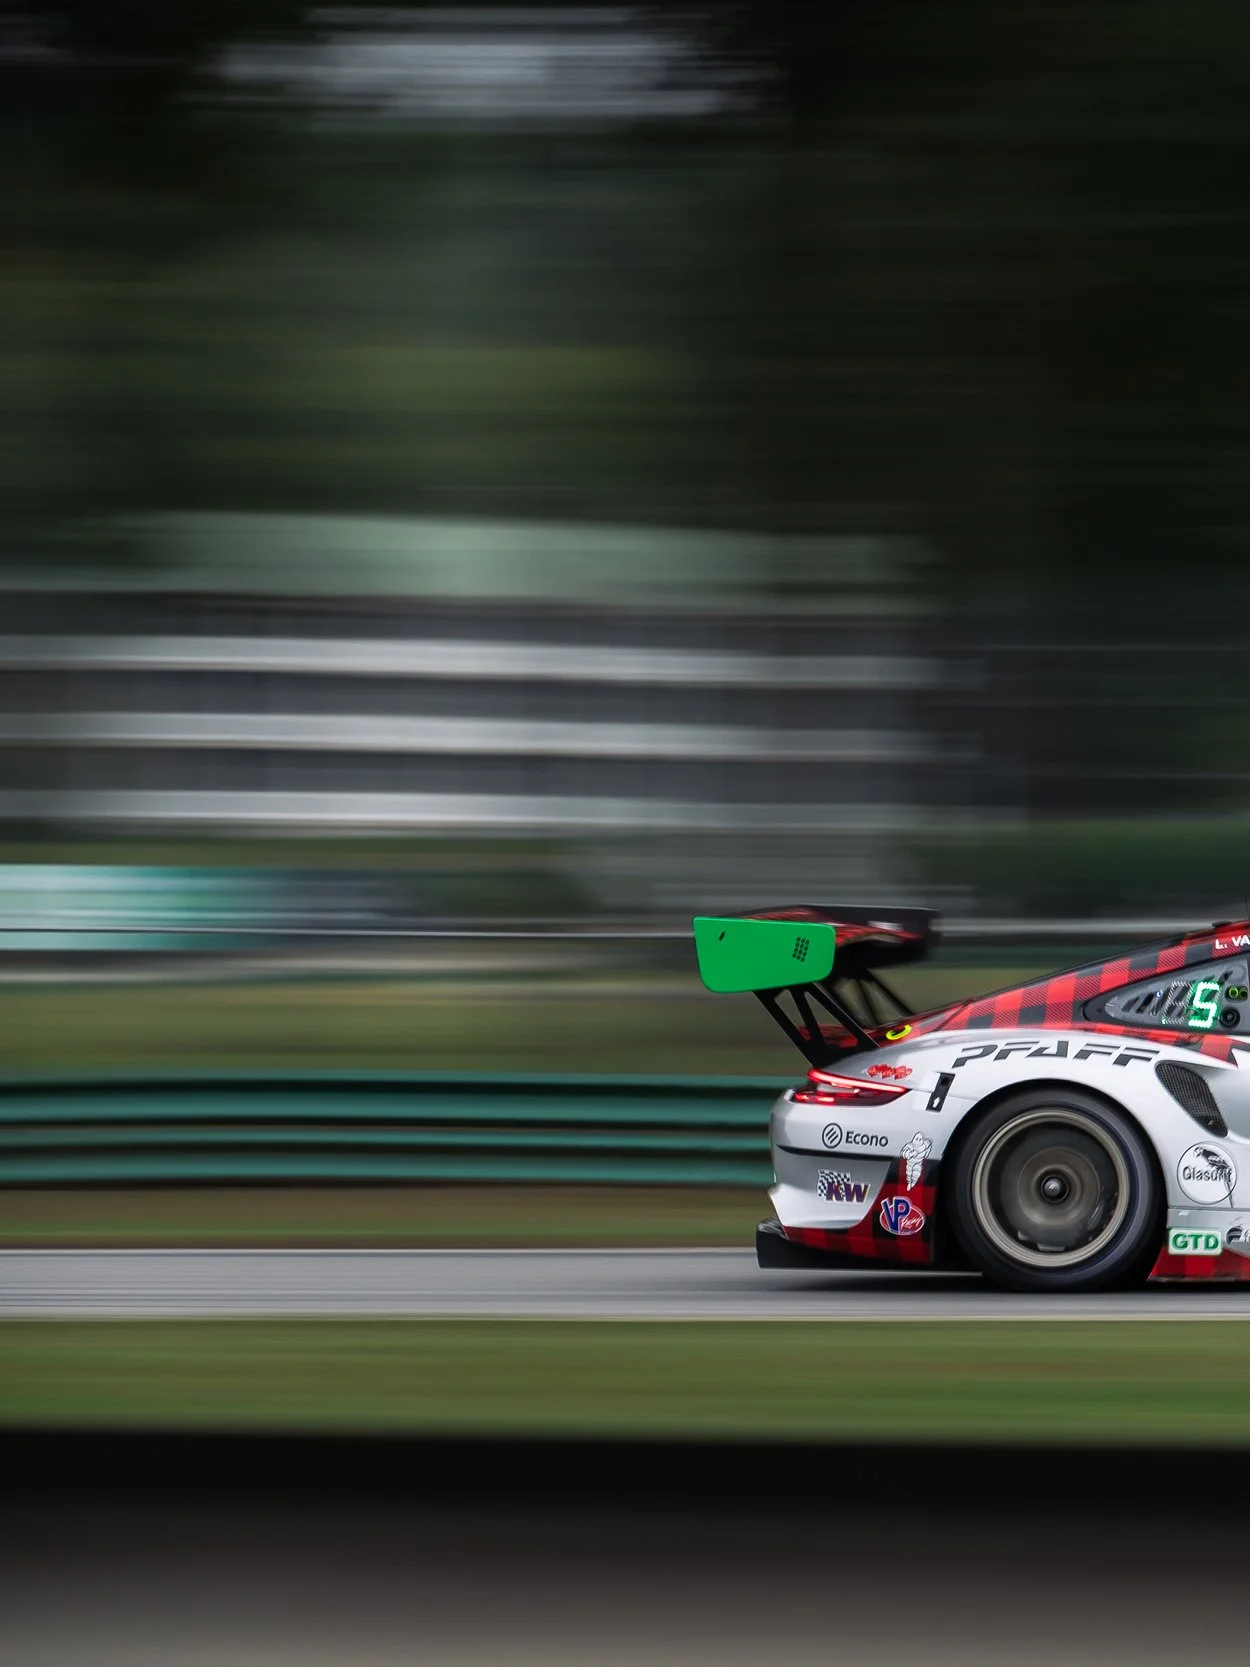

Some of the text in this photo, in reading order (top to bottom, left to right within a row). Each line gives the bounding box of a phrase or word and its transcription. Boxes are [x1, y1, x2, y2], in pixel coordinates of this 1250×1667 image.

[1214, 936, 1228, 950] L.
[1188, 981, 1220, 1028] 5
[951, 1040, 1160, 1068] PFAFF
[845, 1131, 889, 1149] Econo
[881, 1196, 912, 1234] VP
[1172, 1233, 1219, 1251] GTD
